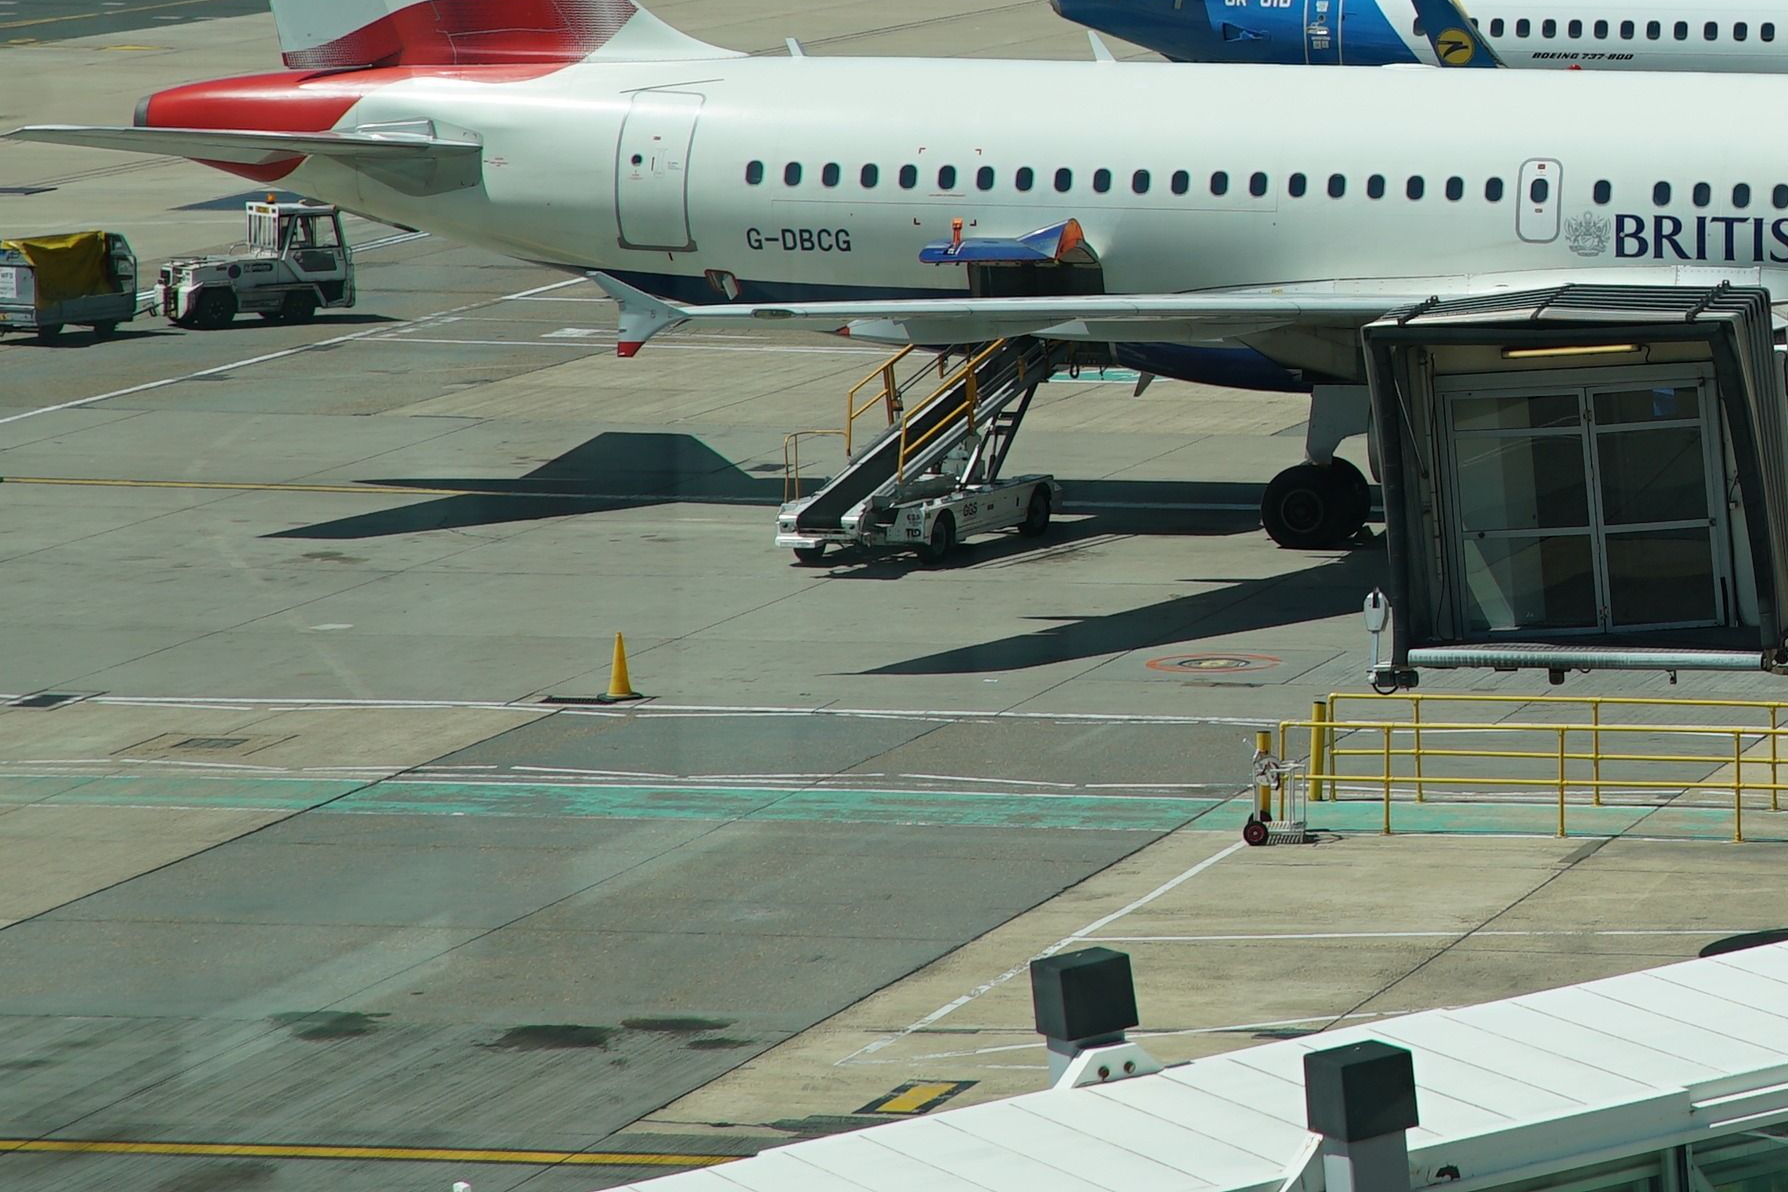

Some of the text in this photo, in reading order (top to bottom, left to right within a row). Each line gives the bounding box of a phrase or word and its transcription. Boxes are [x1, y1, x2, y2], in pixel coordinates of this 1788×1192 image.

[1532, 52, 1635, 61] BOEING 737-800
[746, 227, 852, 251] G-DBCG
